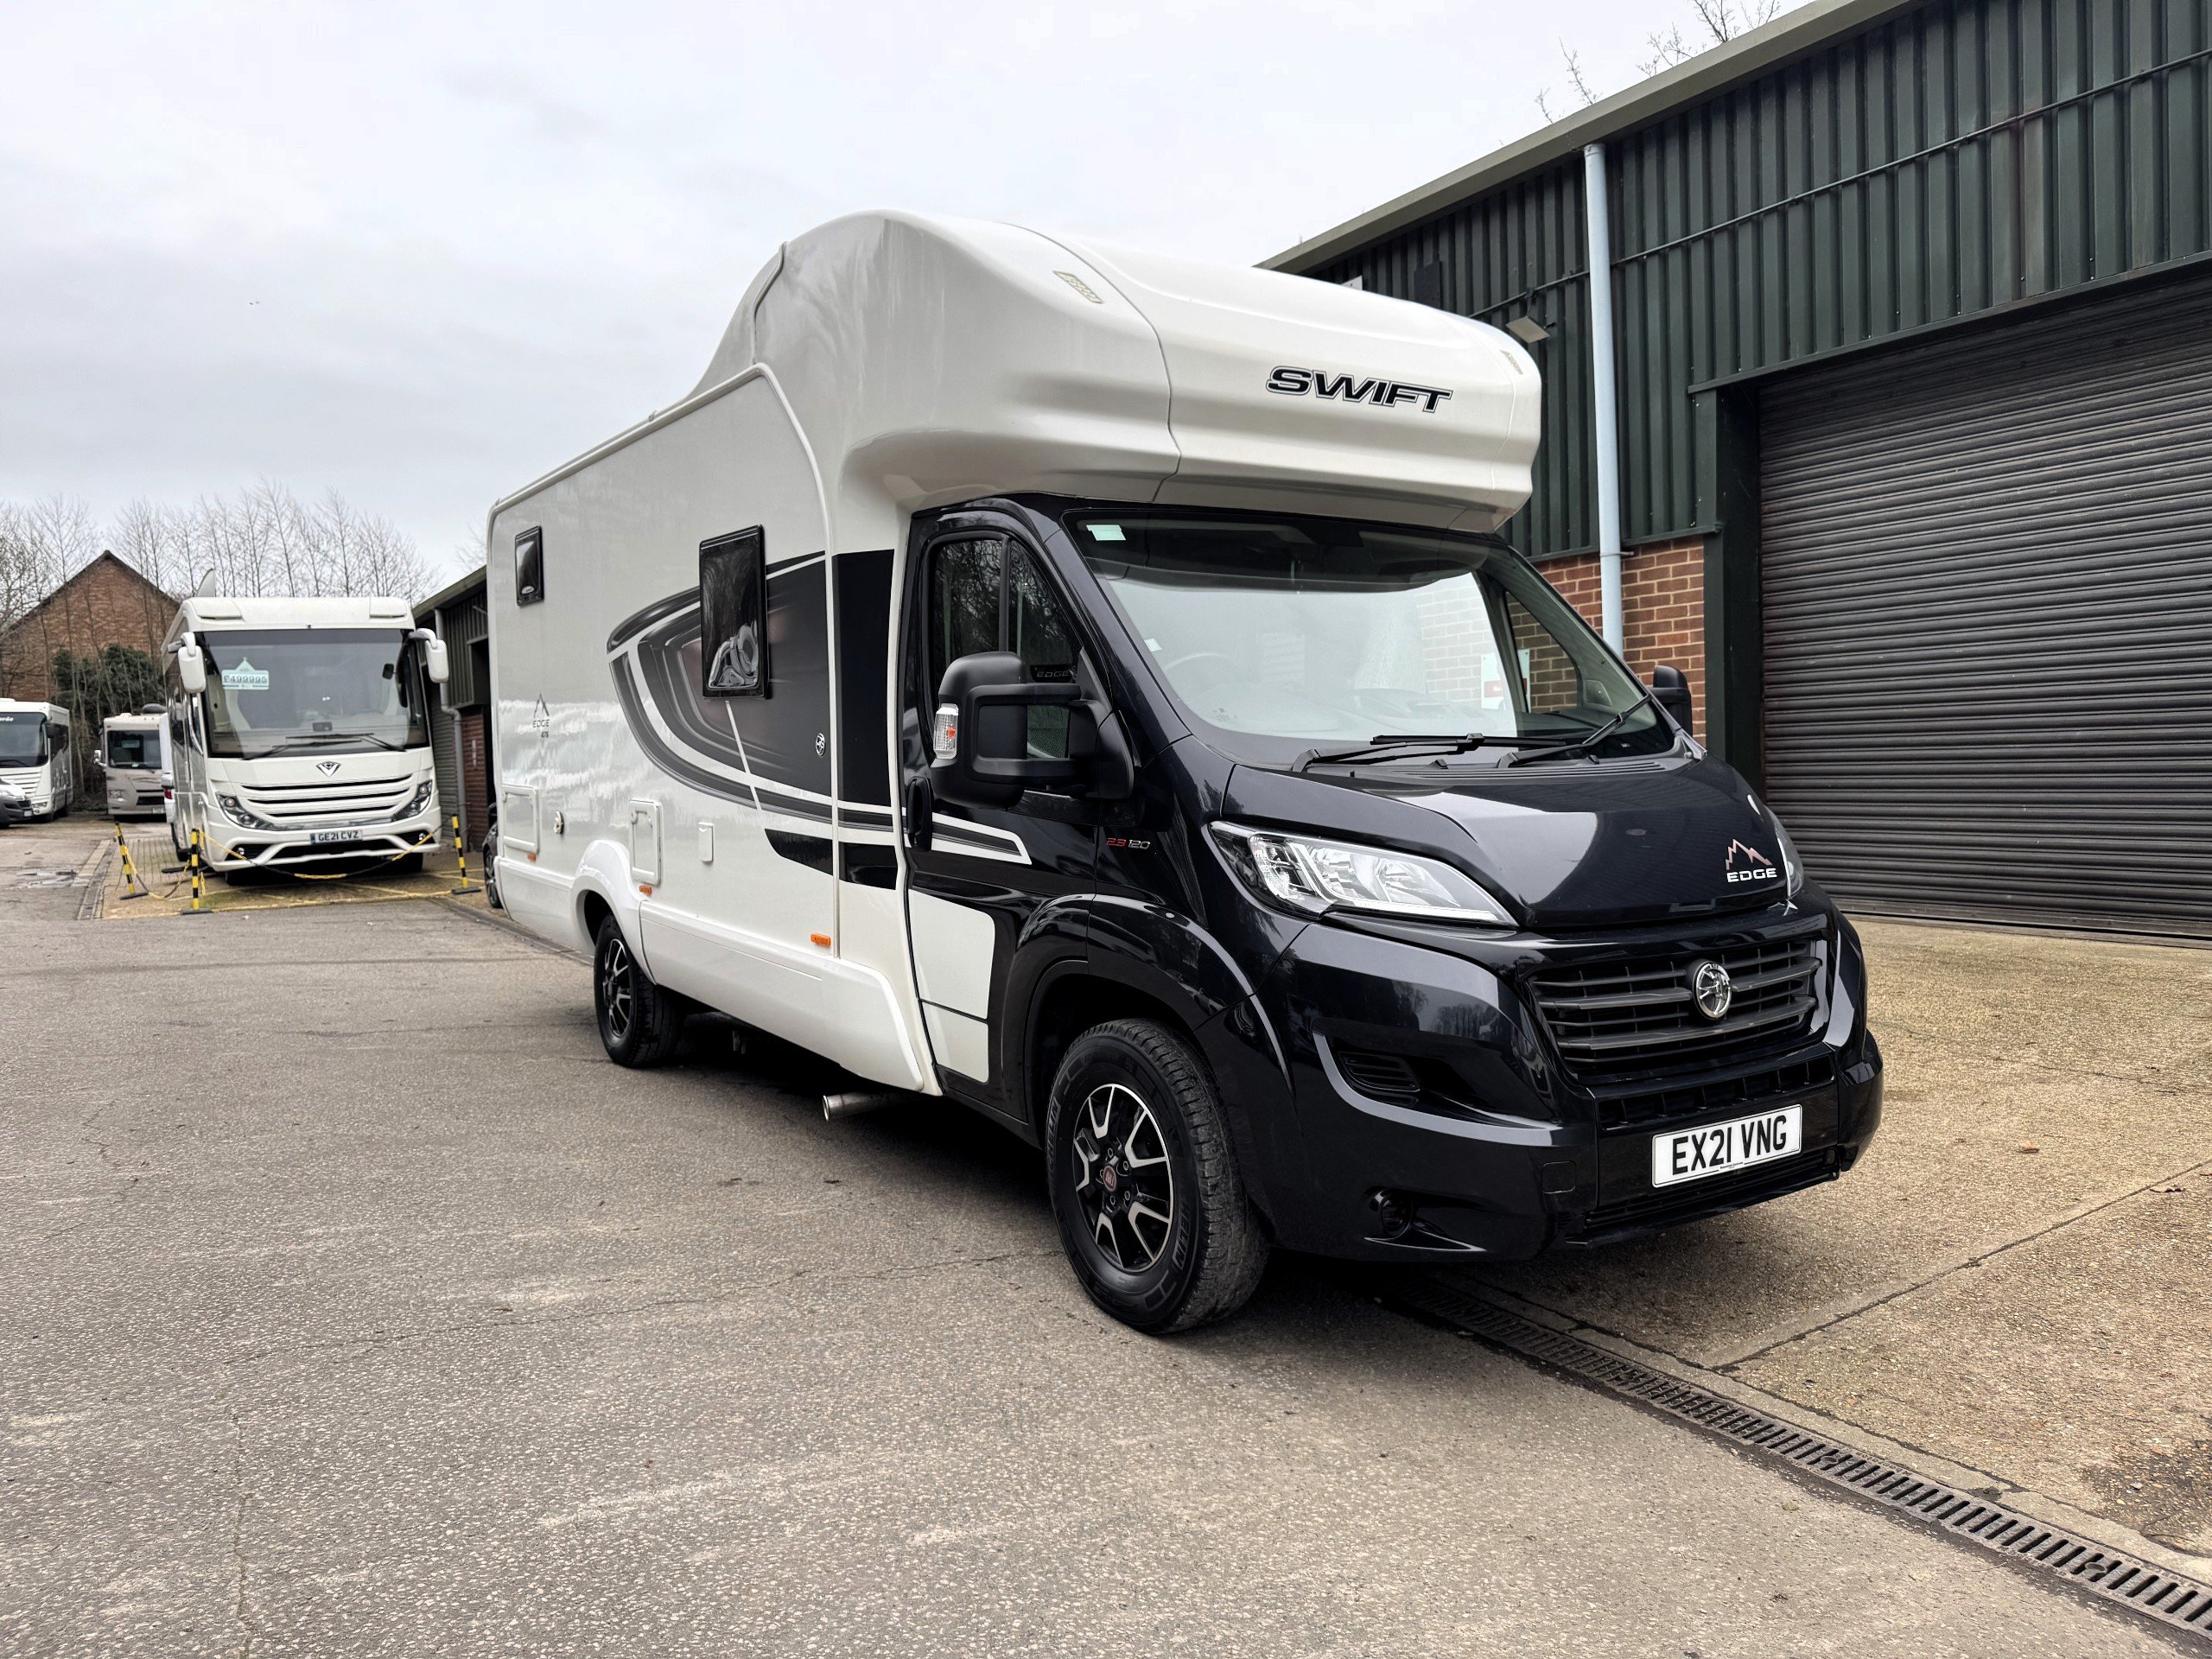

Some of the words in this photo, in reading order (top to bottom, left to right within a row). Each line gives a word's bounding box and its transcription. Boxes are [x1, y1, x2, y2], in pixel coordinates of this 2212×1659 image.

[1266, 365, 1453, 413] SWIFT
[318, 831, 339, 842] GE21
[340, 830, 359, 840] CVZ
[1128, 839, 1151, 850] 120
[1726, 868, 1777, 882] EDGE
[1673, 1126, 1732, 1175] EX21
[1741, 1115, 1787, 1159] VNG
